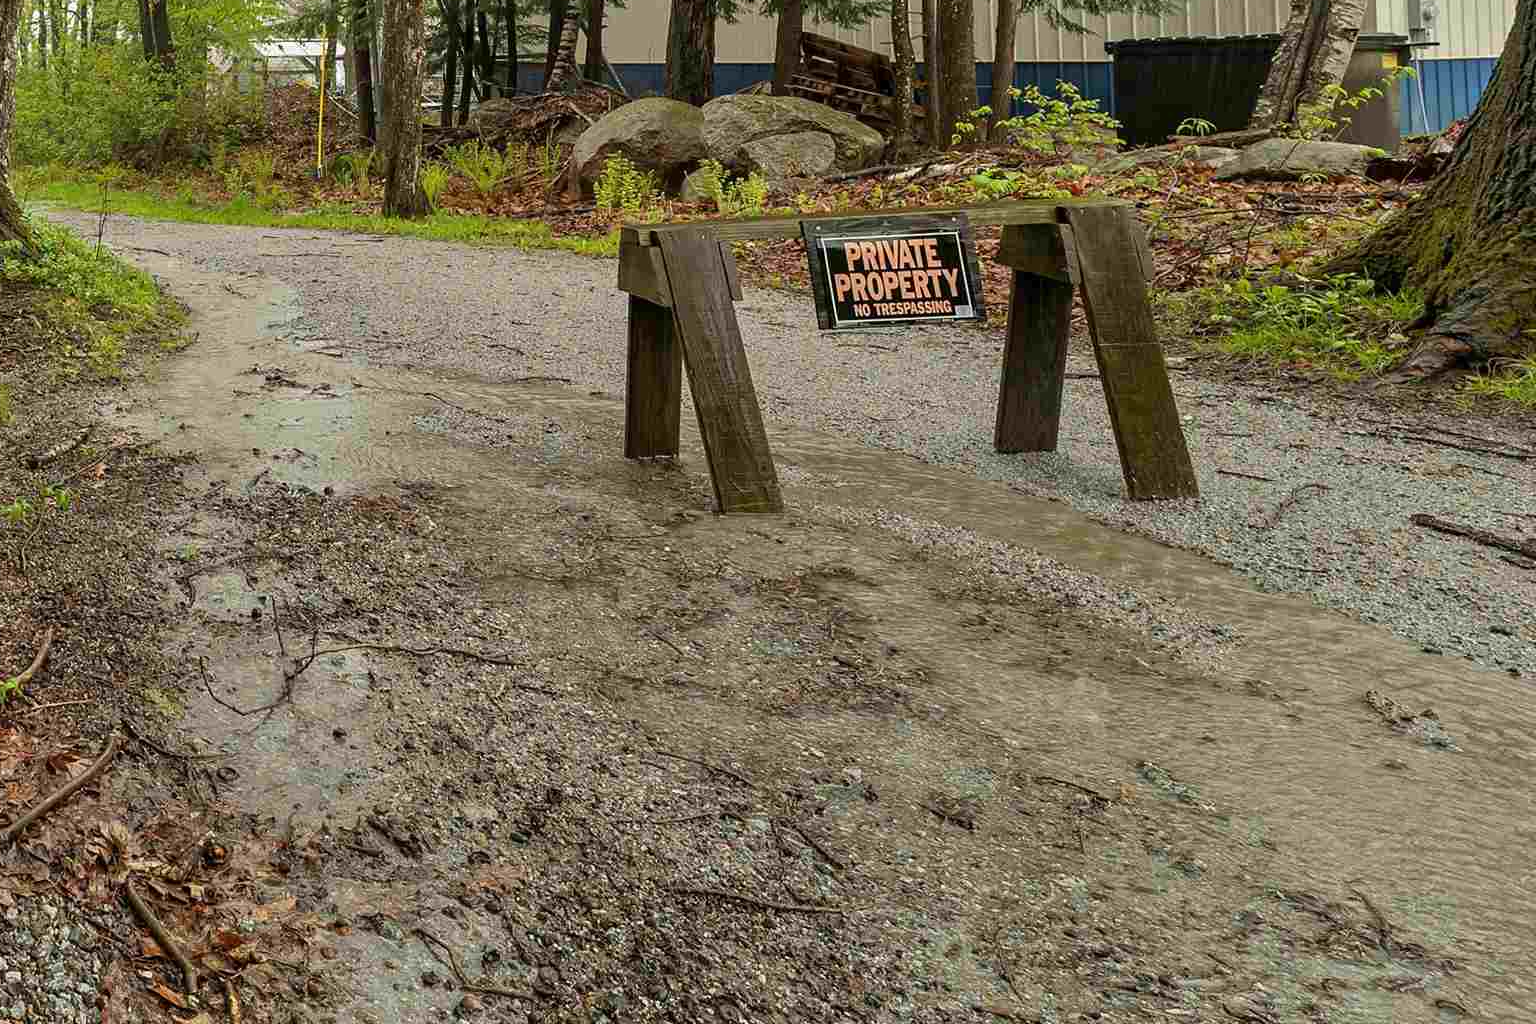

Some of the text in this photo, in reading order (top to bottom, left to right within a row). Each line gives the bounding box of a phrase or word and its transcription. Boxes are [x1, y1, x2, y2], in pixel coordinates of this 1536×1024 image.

[844, 238, 942, 271] PRIVATE
[834, 268, 959, 302] PROPERTY
[853, 300, 953, 317] NO TRESPASSING
